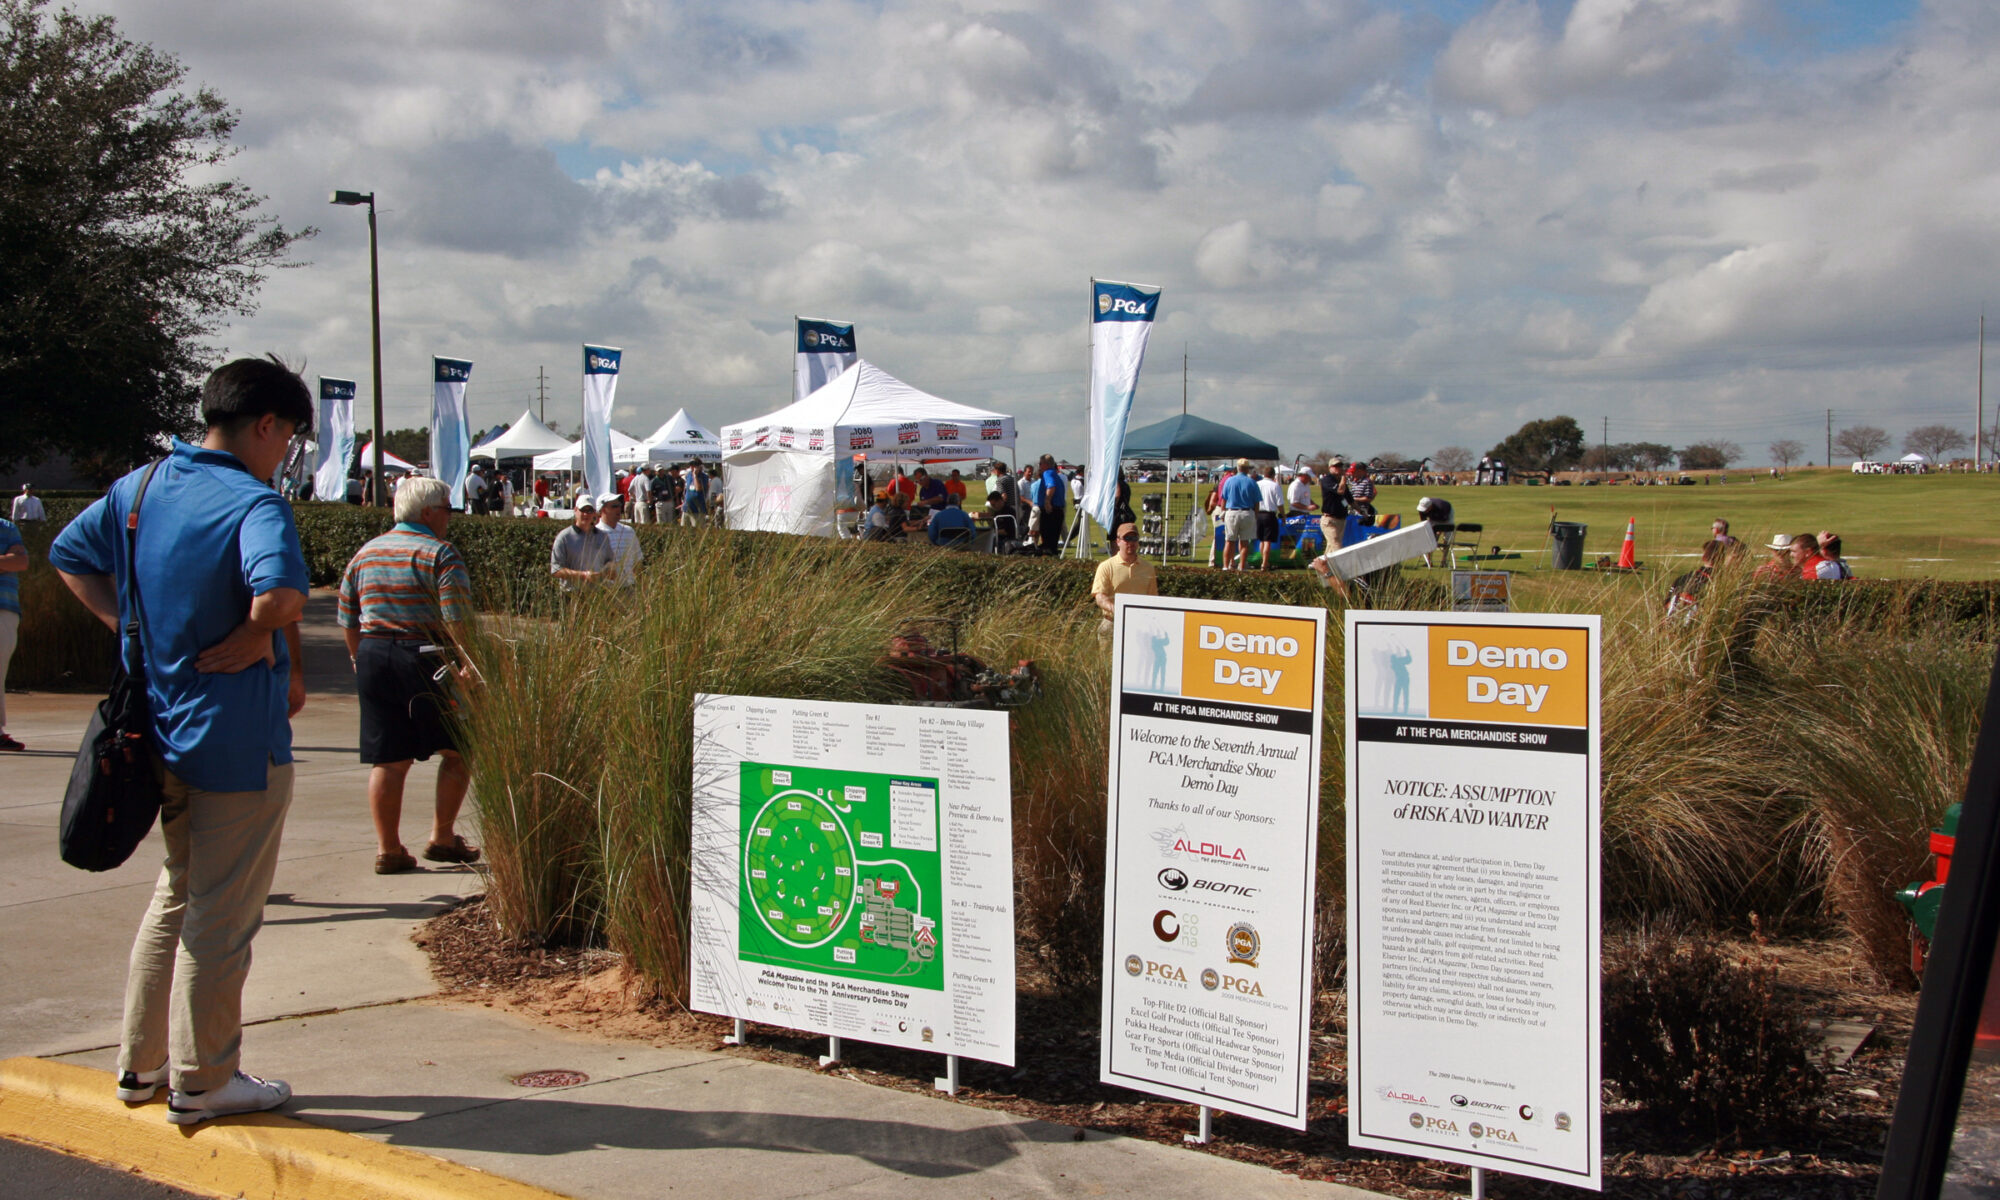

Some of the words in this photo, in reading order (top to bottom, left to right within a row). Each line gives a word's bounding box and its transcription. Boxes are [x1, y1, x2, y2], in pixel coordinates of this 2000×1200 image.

[1112, 298, 1149, 315] PGA
[820, 333, 849, 348] PGA
[334, 386, 354, 396] PGA
[853, 427, 873, 435] 1080
[900, 422, 919, 431] 1080
[881, 446, 979, 456] wwwOrangeWhipTrainer.com
[1199, 625, 1299, 657] Demo
[1447, 639, 1568, 670] Demo
[1214, 658, 1283, 695] Day
[1467, 675, 1550, 713] Day
[1152, 701, 1163, 712] AT
[1164, 702, 1180, 714] THE
[1180, 704, 1197, 715] PGA
[1198, 706, 1254, 722] MERCHANDISE
[1254, 712, 1279, 725] SHOW
[1130, 727, 1179, 746] Welcome
[1179, 734, 1192, 748] to
[1192, 734, 1211, 750] the
[1211, 737, 1255, 755] Seventh
[1255, 743, 1299, 760] Annual
[1395, 726, 1407, 736] AT
[1409, 726, 1427, 738] THE
[1429, 727, 1449, 739] PGA
[1450, 728, 1517, 743] MERCHANDISE
[1518, 732, 1547, 745] SHOW
[1148, 750, 1173, 766] PGA
[1175, 753, 1244, 775] Merchandise
[1245, 762, 1276, 779] Show
[1180, 774, 1214, 791] Demo
[1215, 779, 1239, 798] Day
[1384, 779, 1448, 798] NOTICE:
[1449, 783, 1556, 806] ASSUMPTION
[1148, 797, 1179, 811] Thanks
[1180, 802, 1190, 813] to
[1191, 803, 1204, 815] all
[1205, 805, 1216, 816] of
[1215, 809, 1232, 818] our
[1233, 809, 1276, 825] Sponsors:
[1393, 802, 1410, 819] of
[1409, 804, 1449, 822] RISK
[1449, 807, 1484, 824] AND
[1488, 810, 1549, 830] WAIVER
[1173, 838, 1246, 861] ALDILA
[1381, 848, 1396, 857] Your
[1396, 850, 1431, 860] attendance
[1431, 853, 1440, 861] at,
[1440, 854, 1462, 862] and/or
[1462, 857, 1502, 866] participation
[1503, 860, 1511, 868] in,
[1513, 860, 1532, 869] Demo
[1533, 862, 1545, 871] Day
[761, 969, 775, 978] PGA
[775, 972, 804, 983] Magazine
[805, 978, 817, 986] and
[818, 979, 828, 987] the
[831, 981, 846, 990] PGA
[847, 983, 889, 996] Merchandise
[890, 989, 910, 999] Show
[1144, 976, 1188, 990] MAGAZINE
[1145, 960, 1188, 983] PGA
[757, 977, 785, 988] Welcome
[786, 980, 798, 990] You
[798, 984, 805, 992] to
[806, 984, 817, 994] the
[818, 985, 829, 996] 7th
[831, 987, 871, 1004] Anniversary
[872, 993, 893, 1006] Demo
[893, 996, 908, 1009] Day
[1221, 974, 1264, 998] PGA
[1130, 1006, 1150, 1018] Excel
[1150, 1010, 1167, 1022] Golf
[1167, 1013, 1200, 1029] Products
[1201, 1021, 1230, 1035] (Official
[1232, 1027, 1245, 1038] Tee
[1246, 1030, 1279, 1046] Sponsor)
[1142, 996, 1175, 1011] Top-Flite
[1176, 1003, 1187, 1014] D2
[1188, 1006, 1217, 1020] (Official
[1218, 1012, 1234, 1023] Ball
[1234, 1015, 1268, 1031] Sponsor)
[1124, 1017, 1147, 1030] Pukka
[1148, 1021, 1184, 1037] Headwear
[1185, 1030, 1214, 1044] (Official
[1215, 1036, 1250, 1052] Headwear
[1252, 1044, 1285, 1060] Sponsor)
[1124, 1029, 1142, 1040] Gear
[1143, 1033, 1156, 1044] For
[1156, 1036, 1180, 1049] Sports
[1182, 1041, 1211, 1056] (Official
[1212, 1048, 1250, 1064] Outerwear
[1251, 1057, 1284, 1073] Sponsor)
[1129, 1042, 1142, 1053] Tee
[1143, 1044, 1162, 1057] Time
[1163, 1049, 1185, 1062] Media
[1186, 1054, 1215, 1069] (Official
[1216, 1061, 1243, 1075] Divider
[1244, 1068, 1277, 1084] Sponsor)
[1145, 1057, 1159, 1070] Top
[1160, 1060, 1177, 1073] Tent
[1178, 1065, 1207, 1080] (Official
[1208, 1071, 1225, 1084] Tent
[1226, 1076, 1259, 1092] Sponsor)
[1386, 1090, 1427, 1103] ALDILA
[1426, 1116, 1459, 1132] PGA
[1485, 1126, 1519, 1143] PGA
